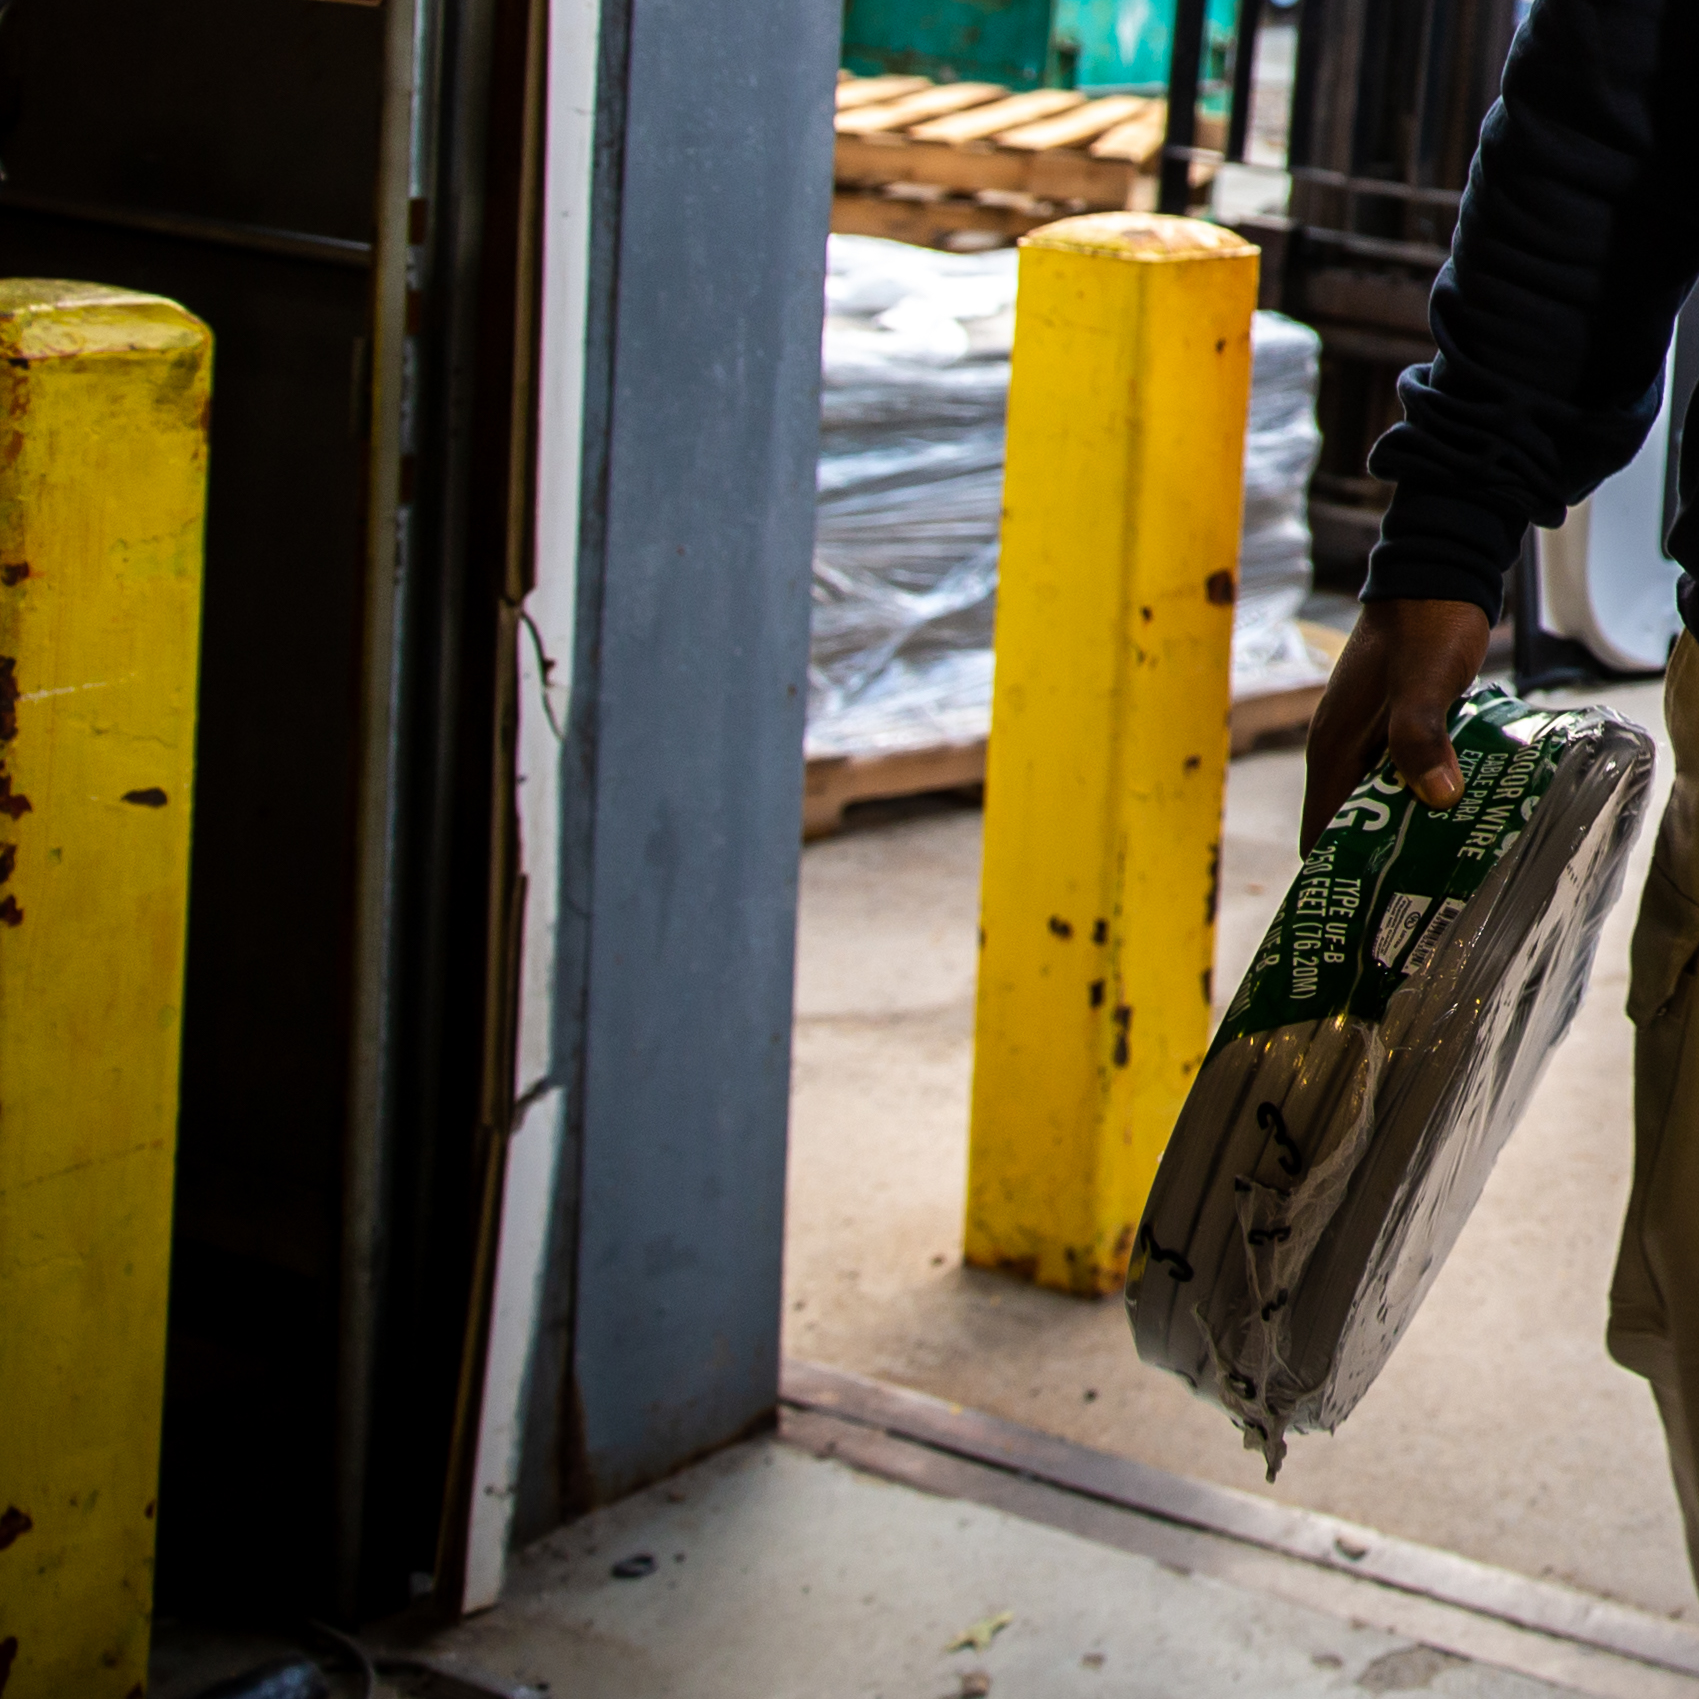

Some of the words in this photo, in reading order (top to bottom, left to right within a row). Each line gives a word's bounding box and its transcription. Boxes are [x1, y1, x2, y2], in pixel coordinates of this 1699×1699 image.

[1472, 753, 1509, 787] CABLE
[1452, 790, 1488, 822] PARA
[1457, 804, 1516, 861] WIRE
[1303, 846, 1336, 875] 250
[1296, 877, 1331, 917] FEET
[1329, 878, 1362, 918] TYPE
[1289, 921, 1324, 1000] (76.20M)
[1323, 922, 1349, 964] UF-B
